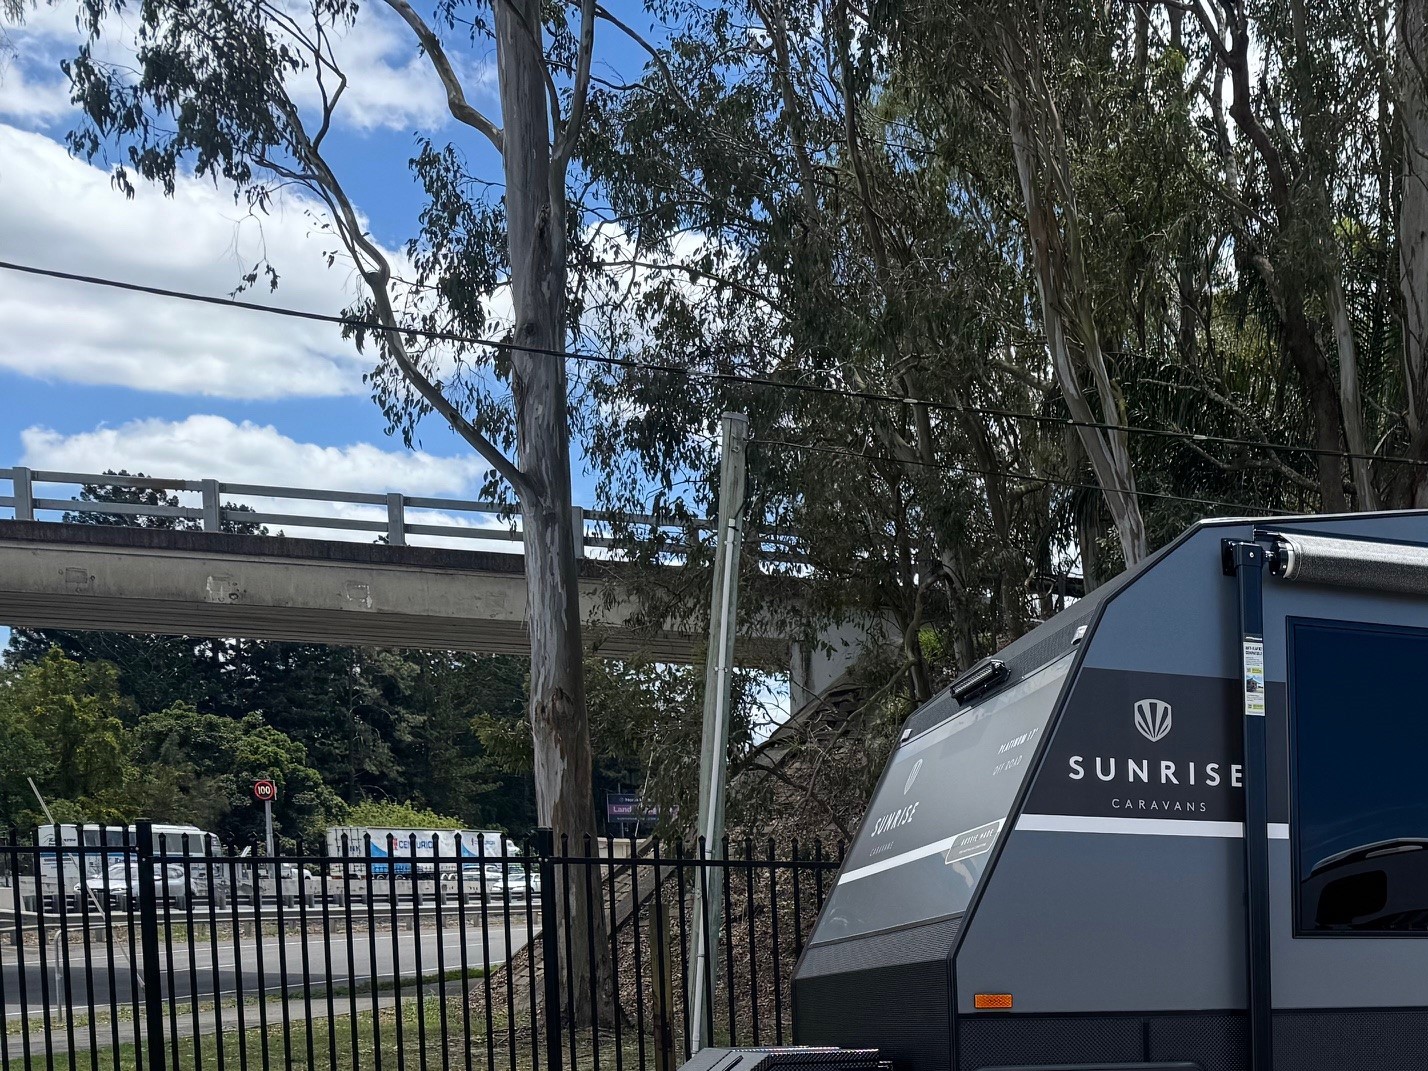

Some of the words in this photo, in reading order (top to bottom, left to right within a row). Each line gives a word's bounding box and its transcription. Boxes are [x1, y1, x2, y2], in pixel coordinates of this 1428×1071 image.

[1068, 755, 1243, 788] SUNRISE
[257, 785, 271, 795] 100
[1111, 798, 1207, 813] CARAVANS
[871, 801, 920, 838] SUNRISE
